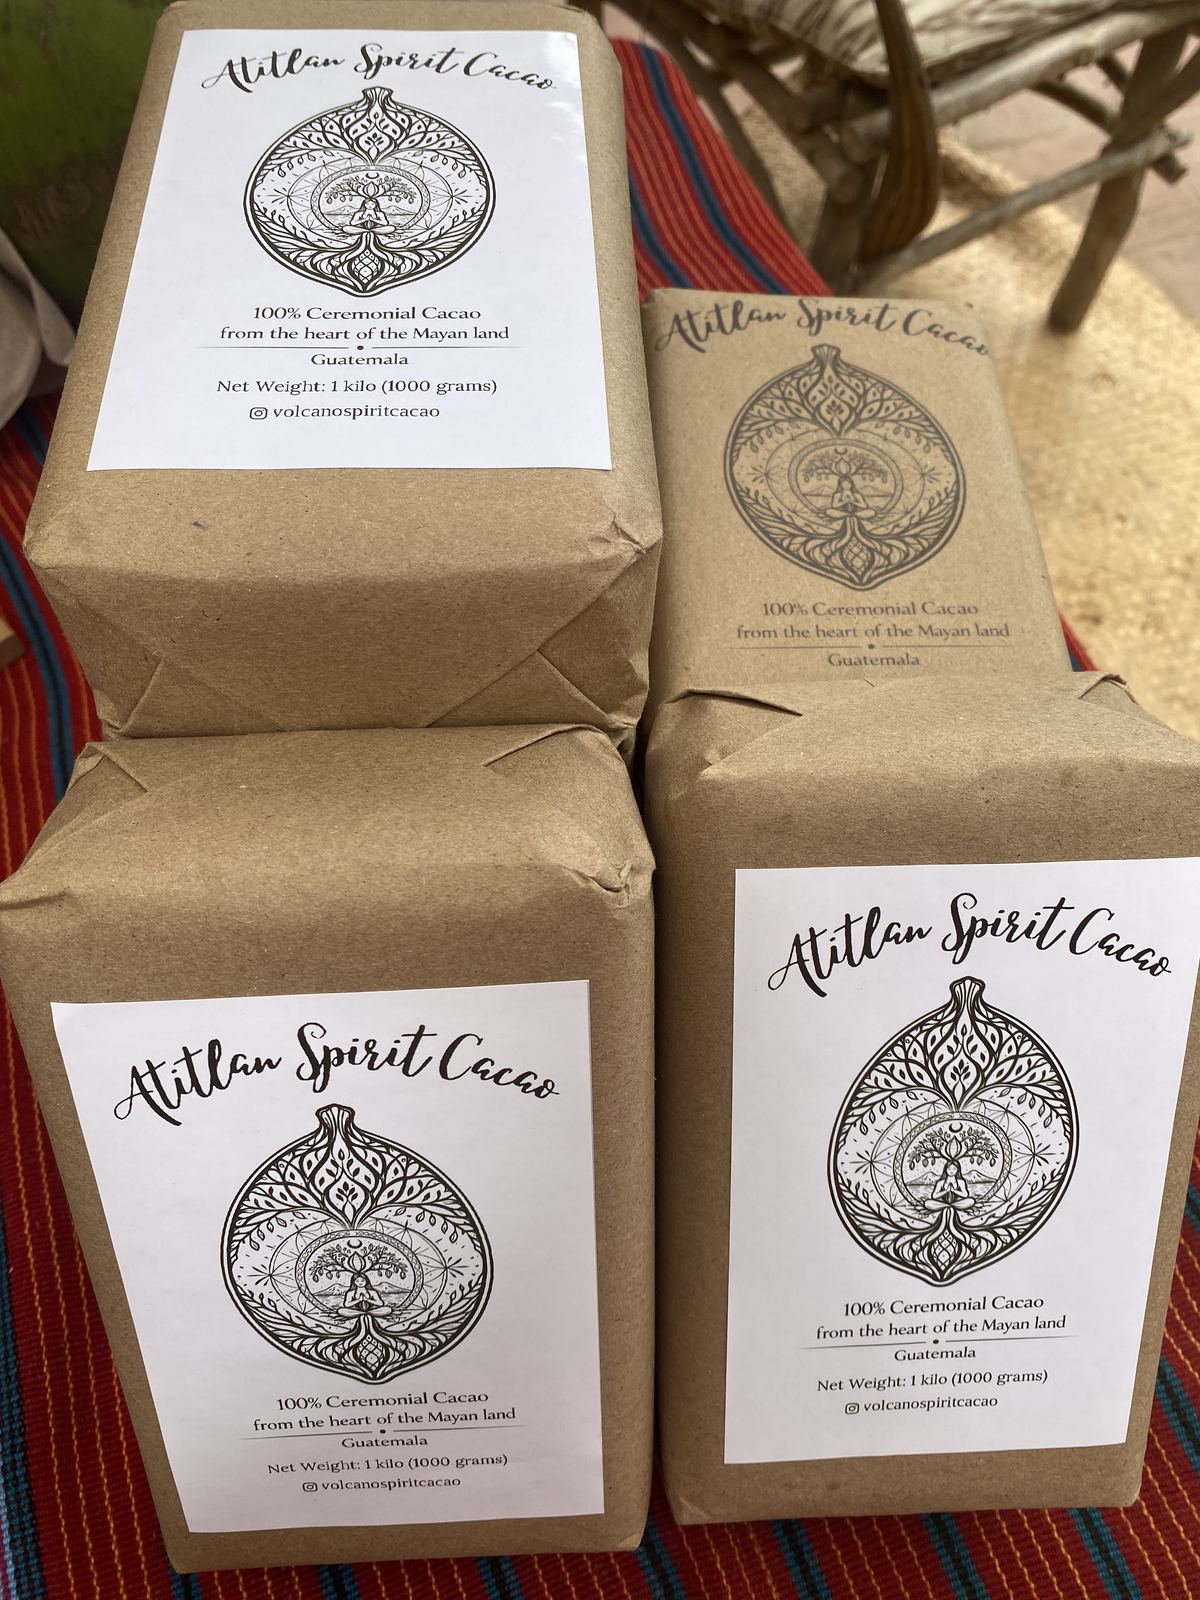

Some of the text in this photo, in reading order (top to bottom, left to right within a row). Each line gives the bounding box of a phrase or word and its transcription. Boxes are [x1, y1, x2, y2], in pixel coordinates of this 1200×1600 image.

[202, 44, 555, 93] Atitlan Spirit Cacao
[254, 306, 480, 319] 100% Ceremonial Cacao
[220, 326, 508, 342] from the heart of the Mayan land
[655, 298, 989, 355] Atitlan Spirit Cacao
[310, 352, 408, 365] Guatemala
[216, 379, 496, 395] Net Weight: 1 kilo (1000 grams)
[273, 404, 439, 420] volcanospiritcacao
[762, 600, 978, 616] 100% Ceremonial Cacao
[737, 622, 1009, 641] from the heart of the Mayan land
[827, 652, 921, 666] Guatemala
[768, 893, 1171, 997] Atitlan Spirit Cacao
[114, 1023, 559, 1126] Atitlan Spirit Cacao
[844, 1295, 1043, 1316] 100% Ceremonial Cacao
[816, 1314, 1066, 1339] from the heart of the Mayan land
[894, 1345, 975, 1361] Guatemala
[817, 1369, 1047, 1391] Net Weight: 1 kilo (1000 grams)
[277, 1391, 488, 1410] 100% Ceremonial Cacao
[863, 1396, 997, 1411] volcanospiritcacao
[253, 1407, 515, 1430] from the heart of the Mayan land
[341, 1434, 427, 1447] Guatemala
[267, 1454, 507, 1473] Net Weight: 1 kilo (1000 grams)
[321, 1477, 460, 1490] volcanospiritcacao
